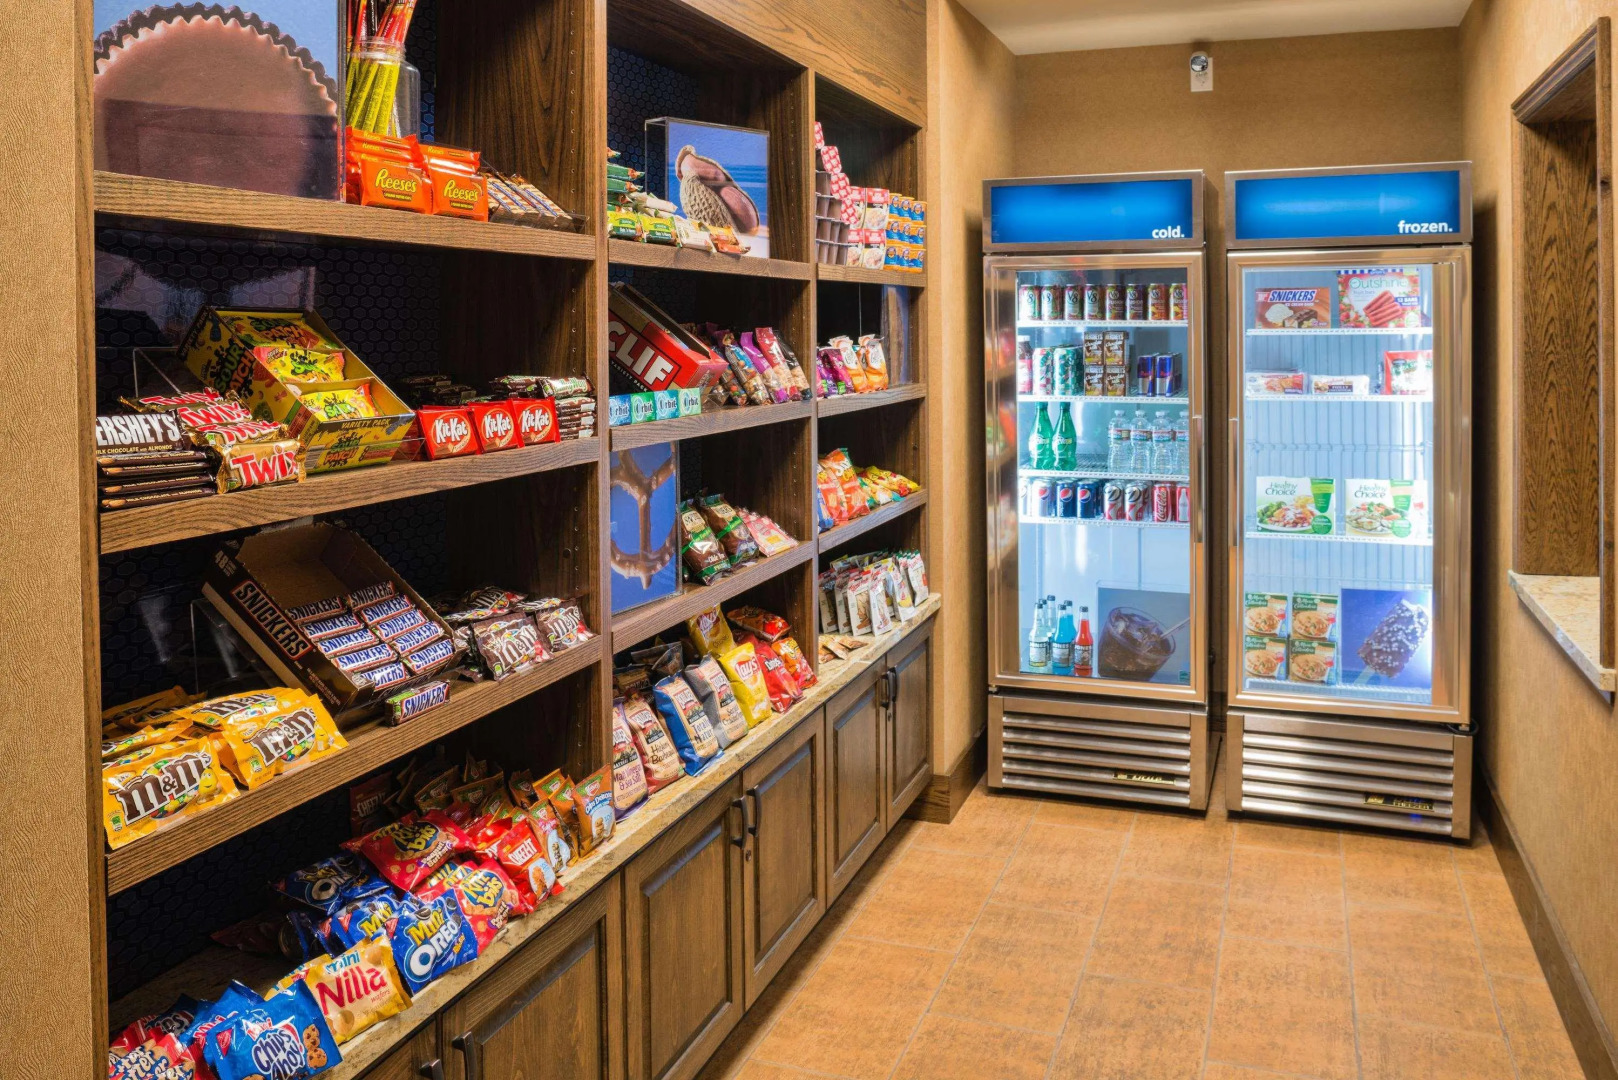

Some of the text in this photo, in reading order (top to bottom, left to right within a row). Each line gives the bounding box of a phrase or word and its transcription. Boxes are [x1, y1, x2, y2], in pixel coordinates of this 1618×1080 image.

[375, 168, 417, 193] Reese's
[443, 179, 478, 201] Reese's
[1152, 225, 1185, 239] cold.
[1398, 220, 1453, 234] frozen.
[1269, 290, 1316, 302] SNICKERS
[609, 320, 674, 385] CLIF
[229, 350, 255, 389] ATCH
[177, 401, 252, 426] Twix
[95, 412, 180, 446] ERSHEY'S
[107, 446, 139, 454] CHOCOLATE
[231, 445, 299, 488] Twix
[1265, 487, 1297, 497] Choice
[1354, 490, 1386, 499] Choice
[349, 581, 394, 607] SNICKERS
[235, 582, 310, 657] SNICKERS
[289, 597, 340, 621] SNICKERS
[364, 594, 411, 621] SNICKERS
[306, 613, 359, 638] SNICKERS
[379, 610, 425, 638] SNICKERS
[394, 621, 440, 651] SNICKERS
[321, 629, 375, 653] SNICKERS
[337, 644, 392, 669] SNICKERS
[737, 659, 759, 677] Lay's
[402, 683, 447, 718] SNICKERS
[109, 751, 212, 826] m&m's
[408, 907, 445, 945] Mini
[409, 920, 459, 977] OREO
[326, 949, 361, 975] mini
[315, 964, 388, 1016] Nilla
[253, 1029, 292, 1065] Chips
